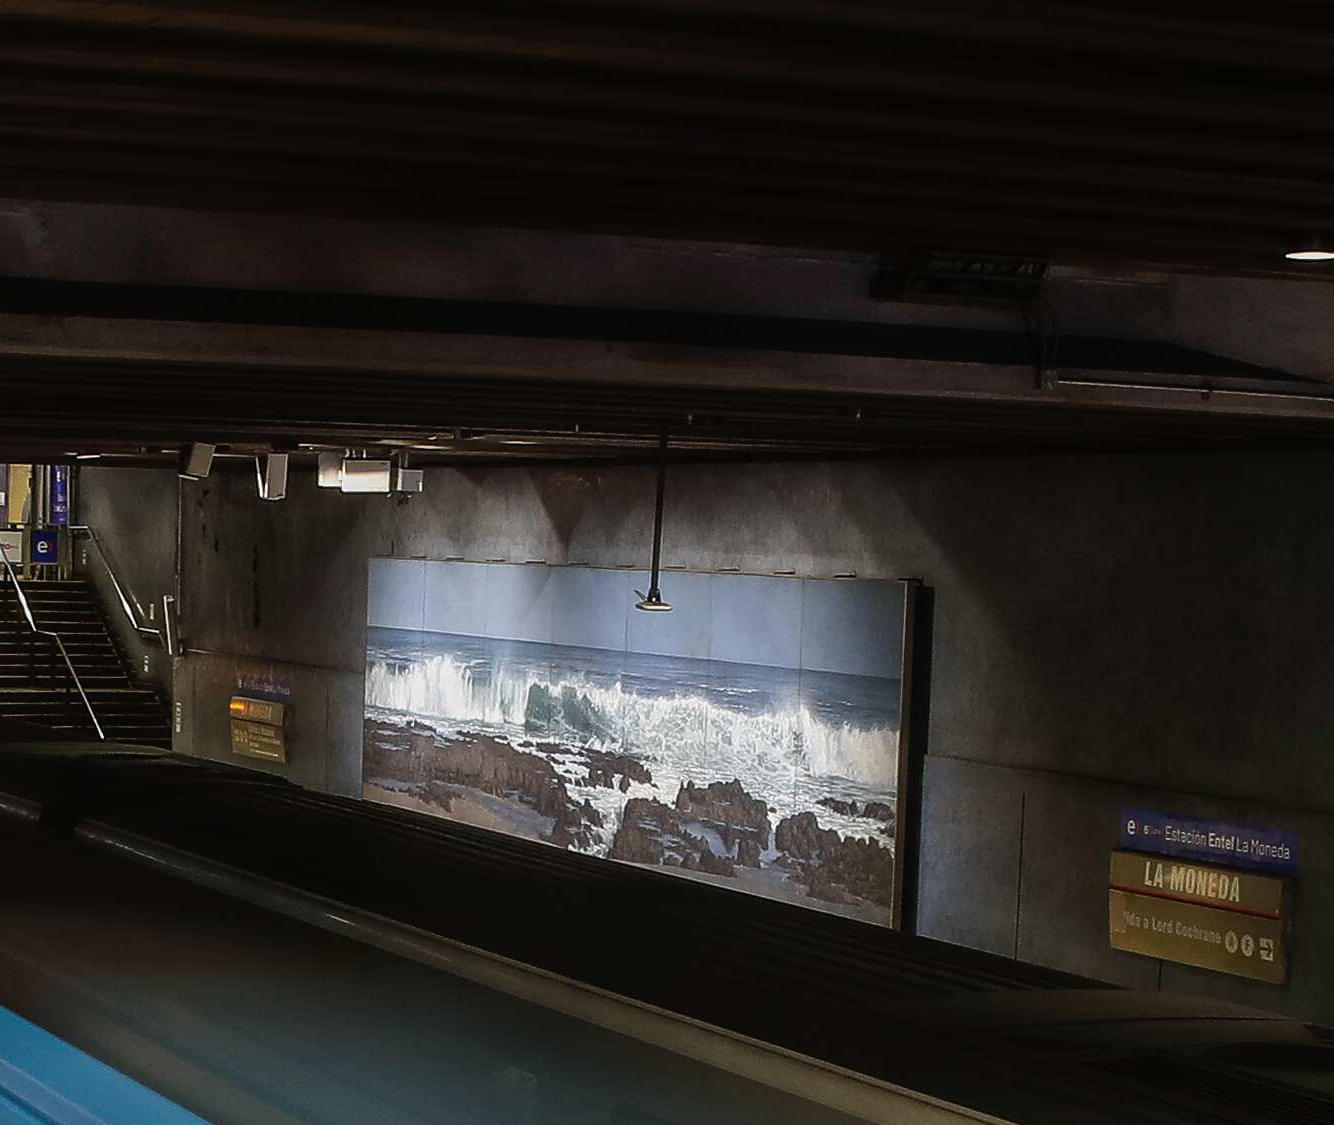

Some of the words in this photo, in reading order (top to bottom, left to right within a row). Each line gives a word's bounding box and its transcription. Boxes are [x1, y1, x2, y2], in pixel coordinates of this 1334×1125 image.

[1208, 832, 1235, 850] Entel
[1236, 839, 1248, 853] La
[1250, 839, 1291, 860] Moneda
[1144, 861, 1163, 889] LA
[1170, 866, 1240, 903] MONEDA
